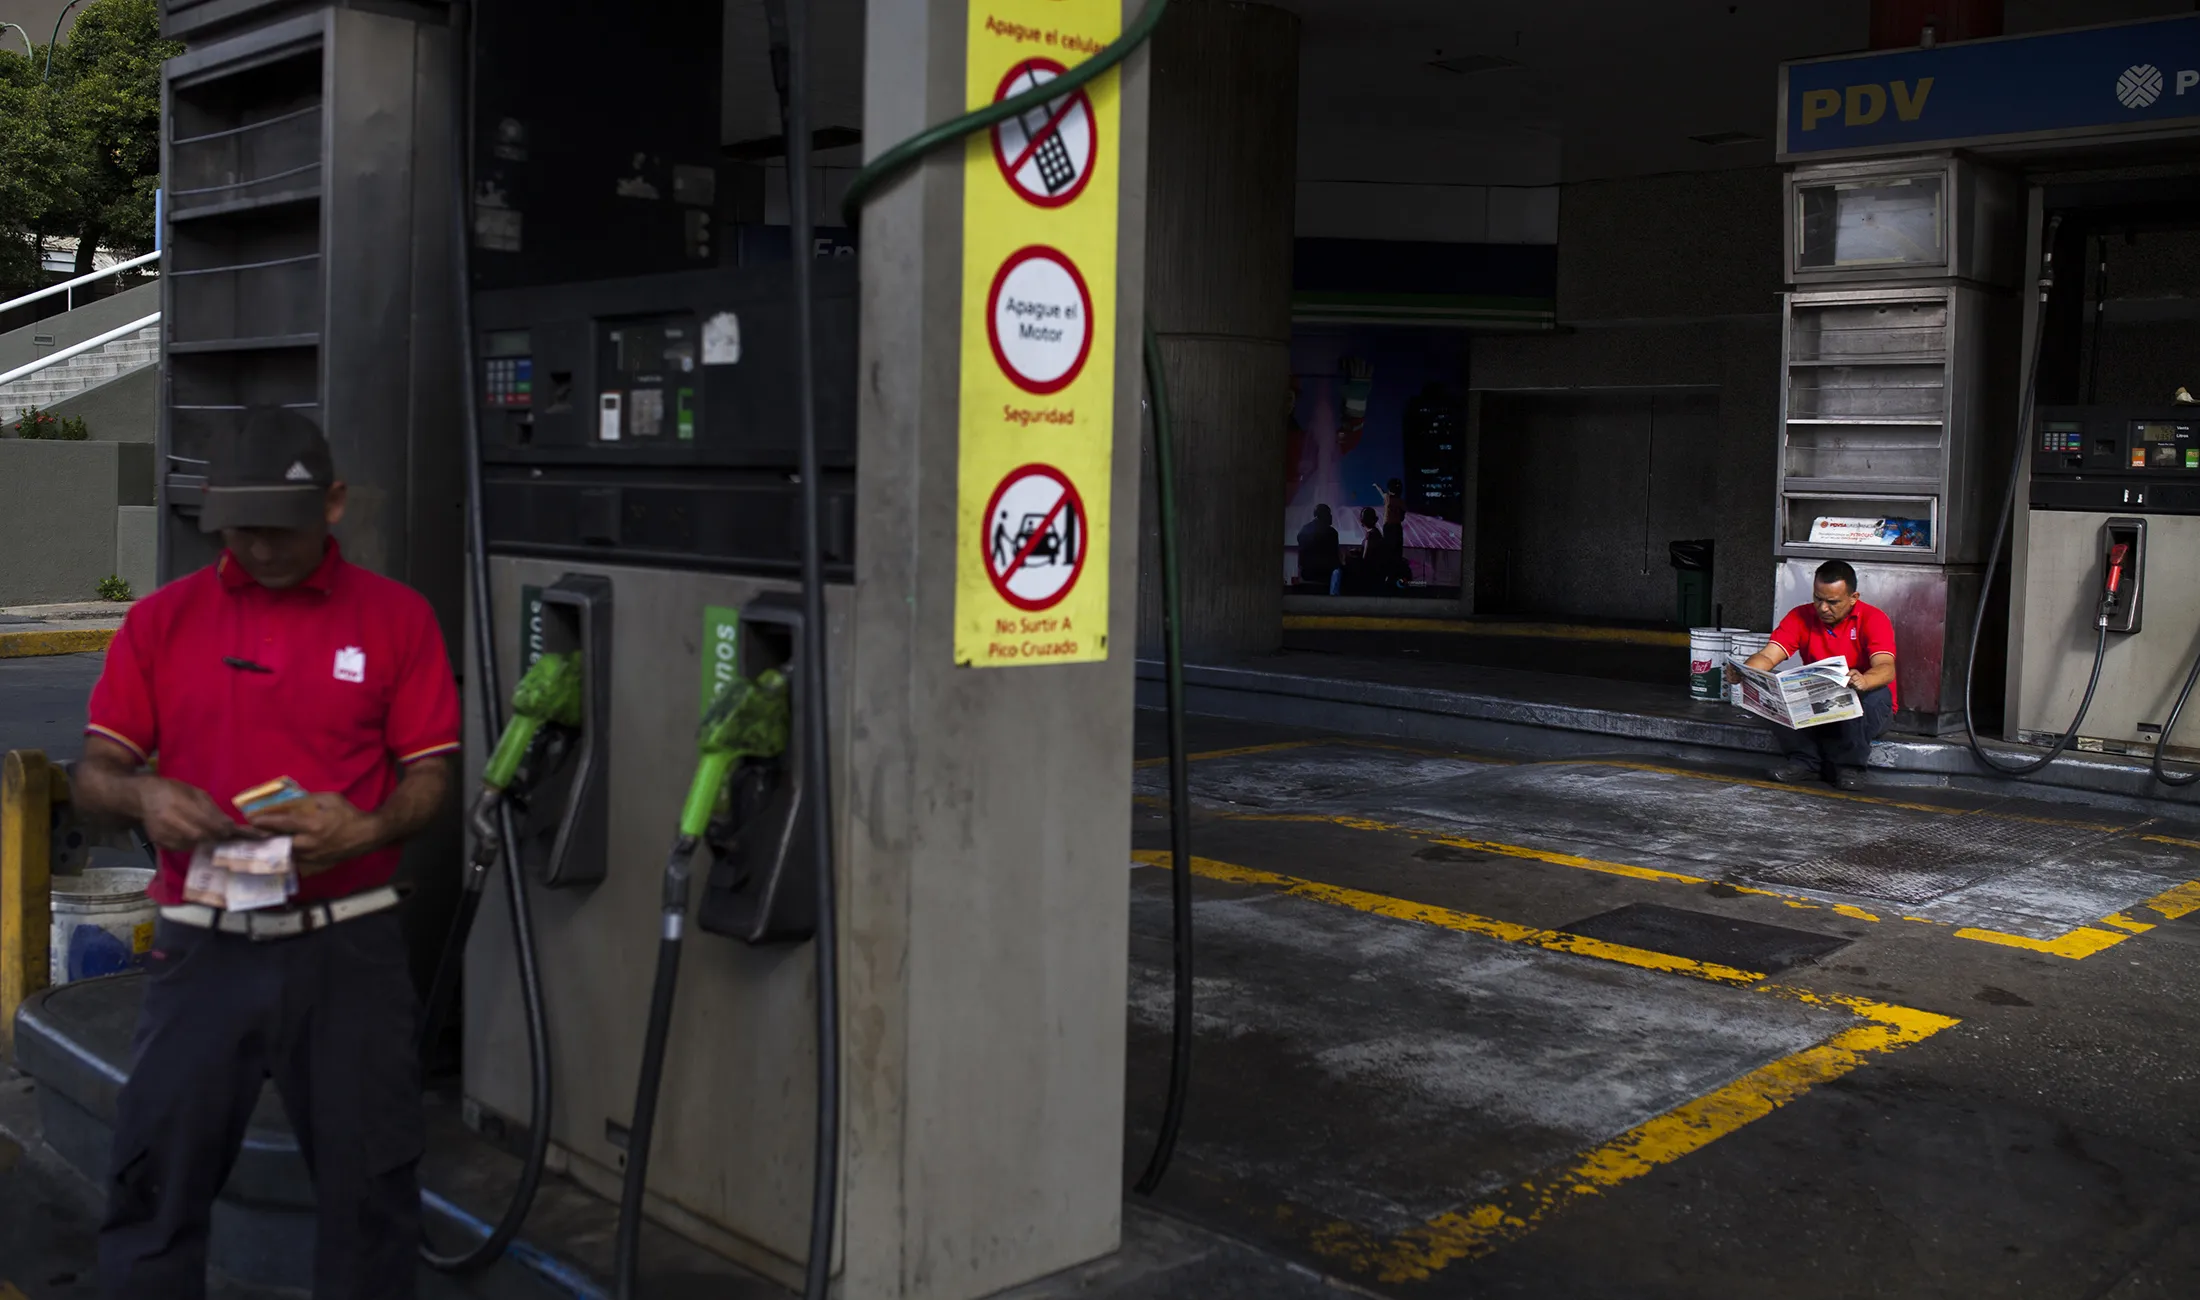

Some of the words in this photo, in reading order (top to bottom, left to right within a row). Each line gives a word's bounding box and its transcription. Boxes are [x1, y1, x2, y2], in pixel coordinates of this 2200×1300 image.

[985, 14, 1041, 43] Apague
[1045, 29, 1058, 46] el
[1802, 77, 1935, 131] PDV
[1006, 297, 1061, 320] Apague
[1064, 303, 1078, 319] el
[1019, 323, 1063, 343] Motor
[1003, 404, 1075, 427] Seguridad
[996, 618, 1017, 634] No
[1020, 616, 1058, 634] Surtir
[1061, 615, 1072, 632] A
[989, 641, 1018, 658] Pico
[1021, 639, 1078, 657] Cruzado
